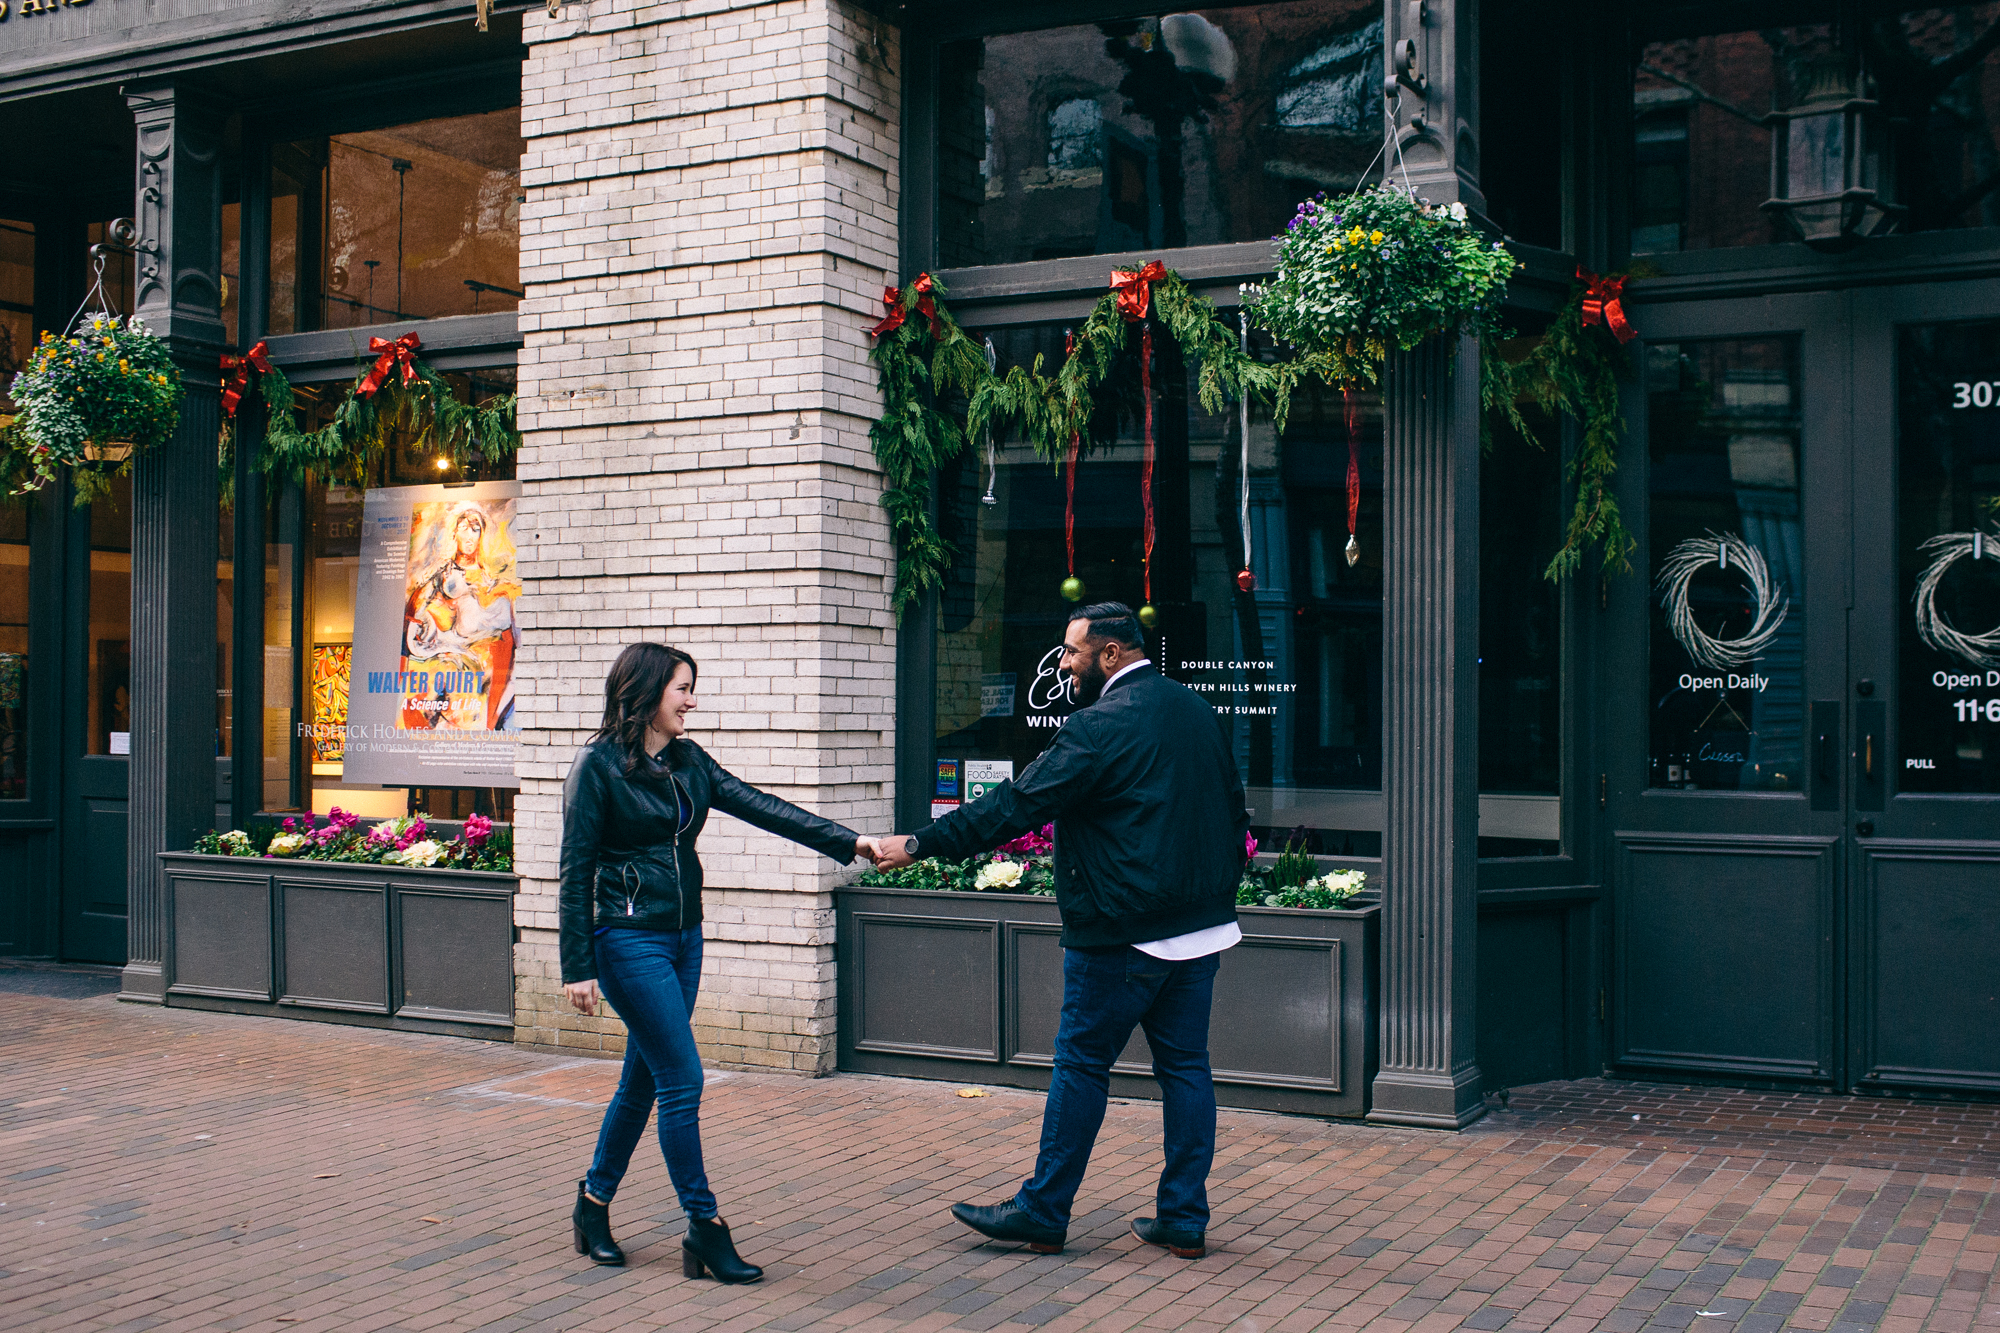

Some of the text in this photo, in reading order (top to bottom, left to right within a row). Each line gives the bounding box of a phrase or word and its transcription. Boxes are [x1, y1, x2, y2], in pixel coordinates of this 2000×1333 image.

[1181, 661, 1274, 670] DOUBLE CANYON
[368, 671, 485, 696] WALTER QUIRT
[1678, 672, 1770, 693] Open Daily
[1932, 670, 1982, 690] Open
[1182, 683, 1297, 692] EVEN HILLS WINERY
[400, 698, 482, 711] A Science of Life
[1212, 706, 1278, 715] RY SUMMIT
[373, 724, 429, 740] HOLMES
[434, 726, 465, 741] AND
[1906, 758, 1936, 769] PULL
[968, 771, 992, 779] FOOD
